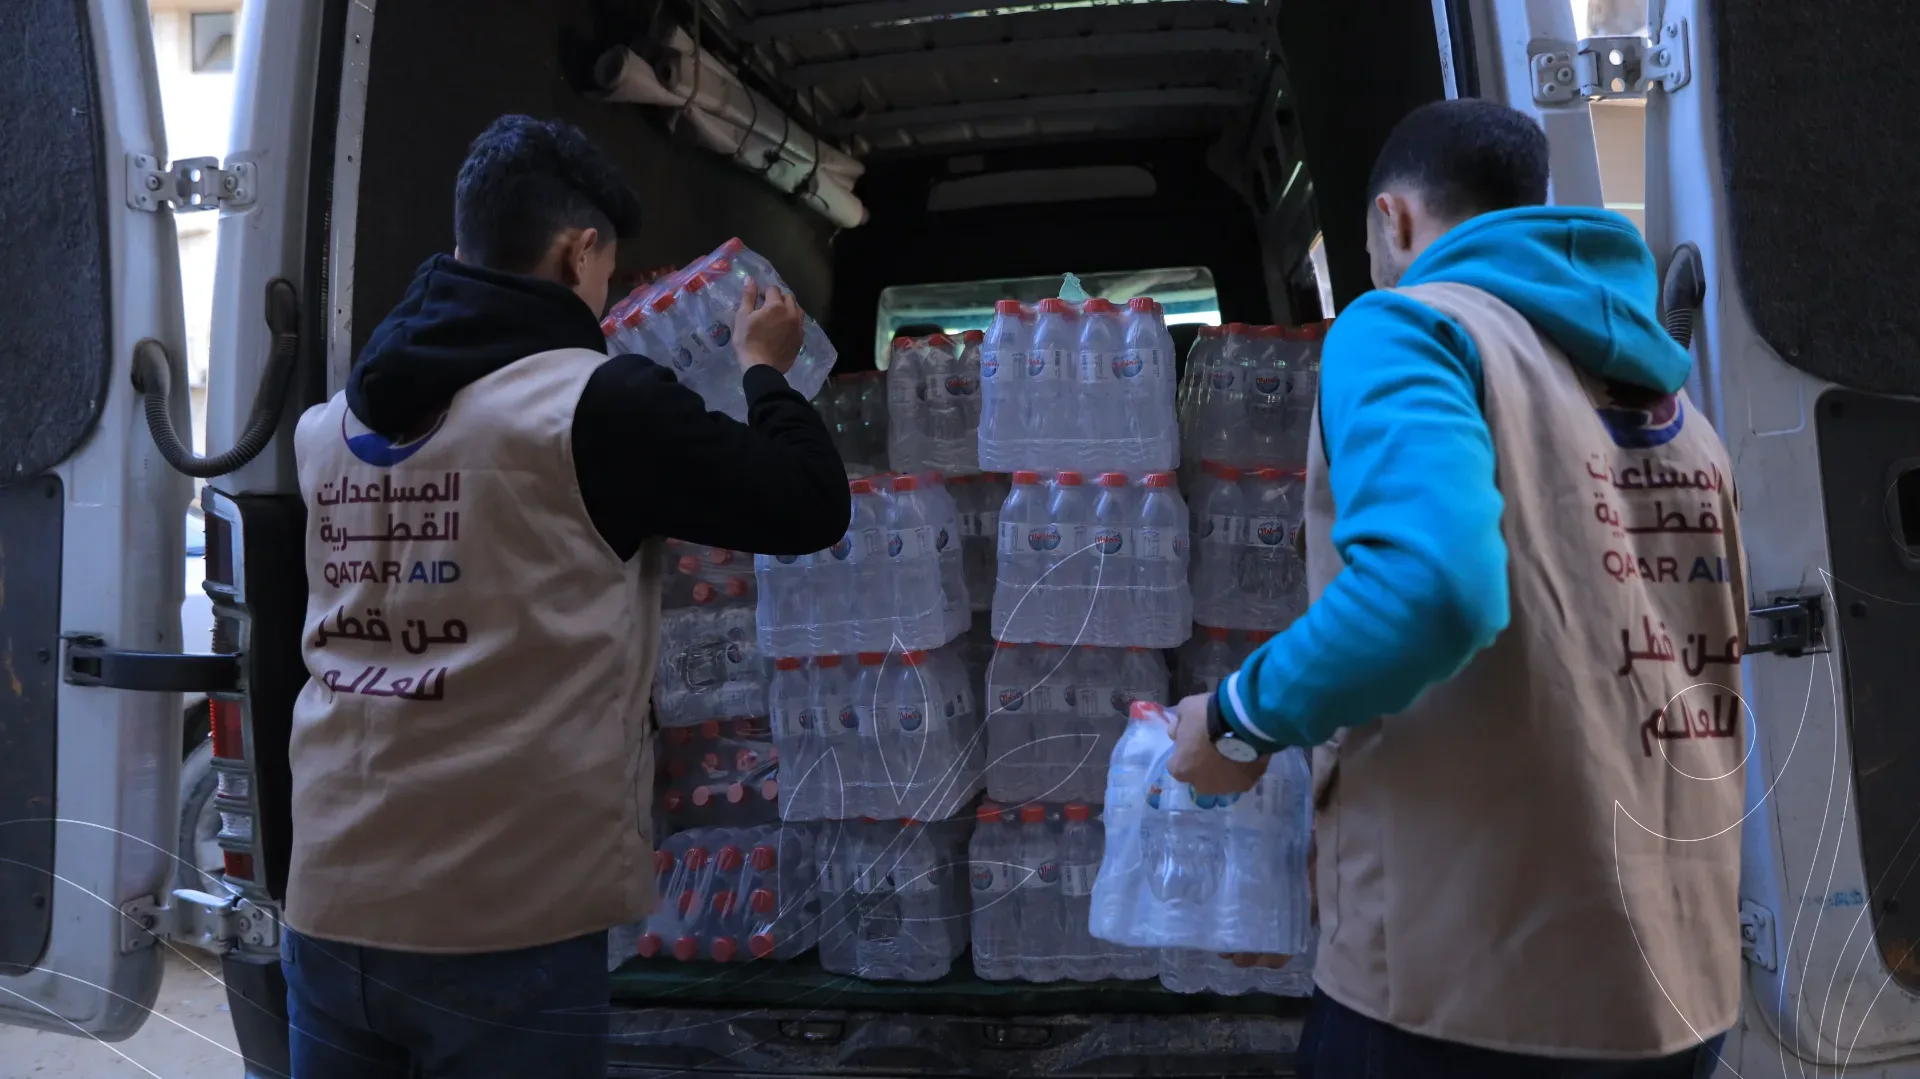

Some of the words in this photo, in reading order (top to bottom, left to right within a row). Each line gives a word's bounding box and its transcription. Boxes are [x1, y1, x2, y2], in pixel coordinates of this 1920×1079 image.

[317, 472, 460, 506] المساعدات
[320, 511, 459, 552] القطرية
[324, 561, 401, 588] QATAR
[408, 561, 461, 584] AID
[1602, 550, 1680, 583] QAAR
[1687, 556, 1729, 583] AI
[315, 604, 392, 648] قطر
[402, 618, 468, 654] من
[1682, 633, 1740, 677] من
